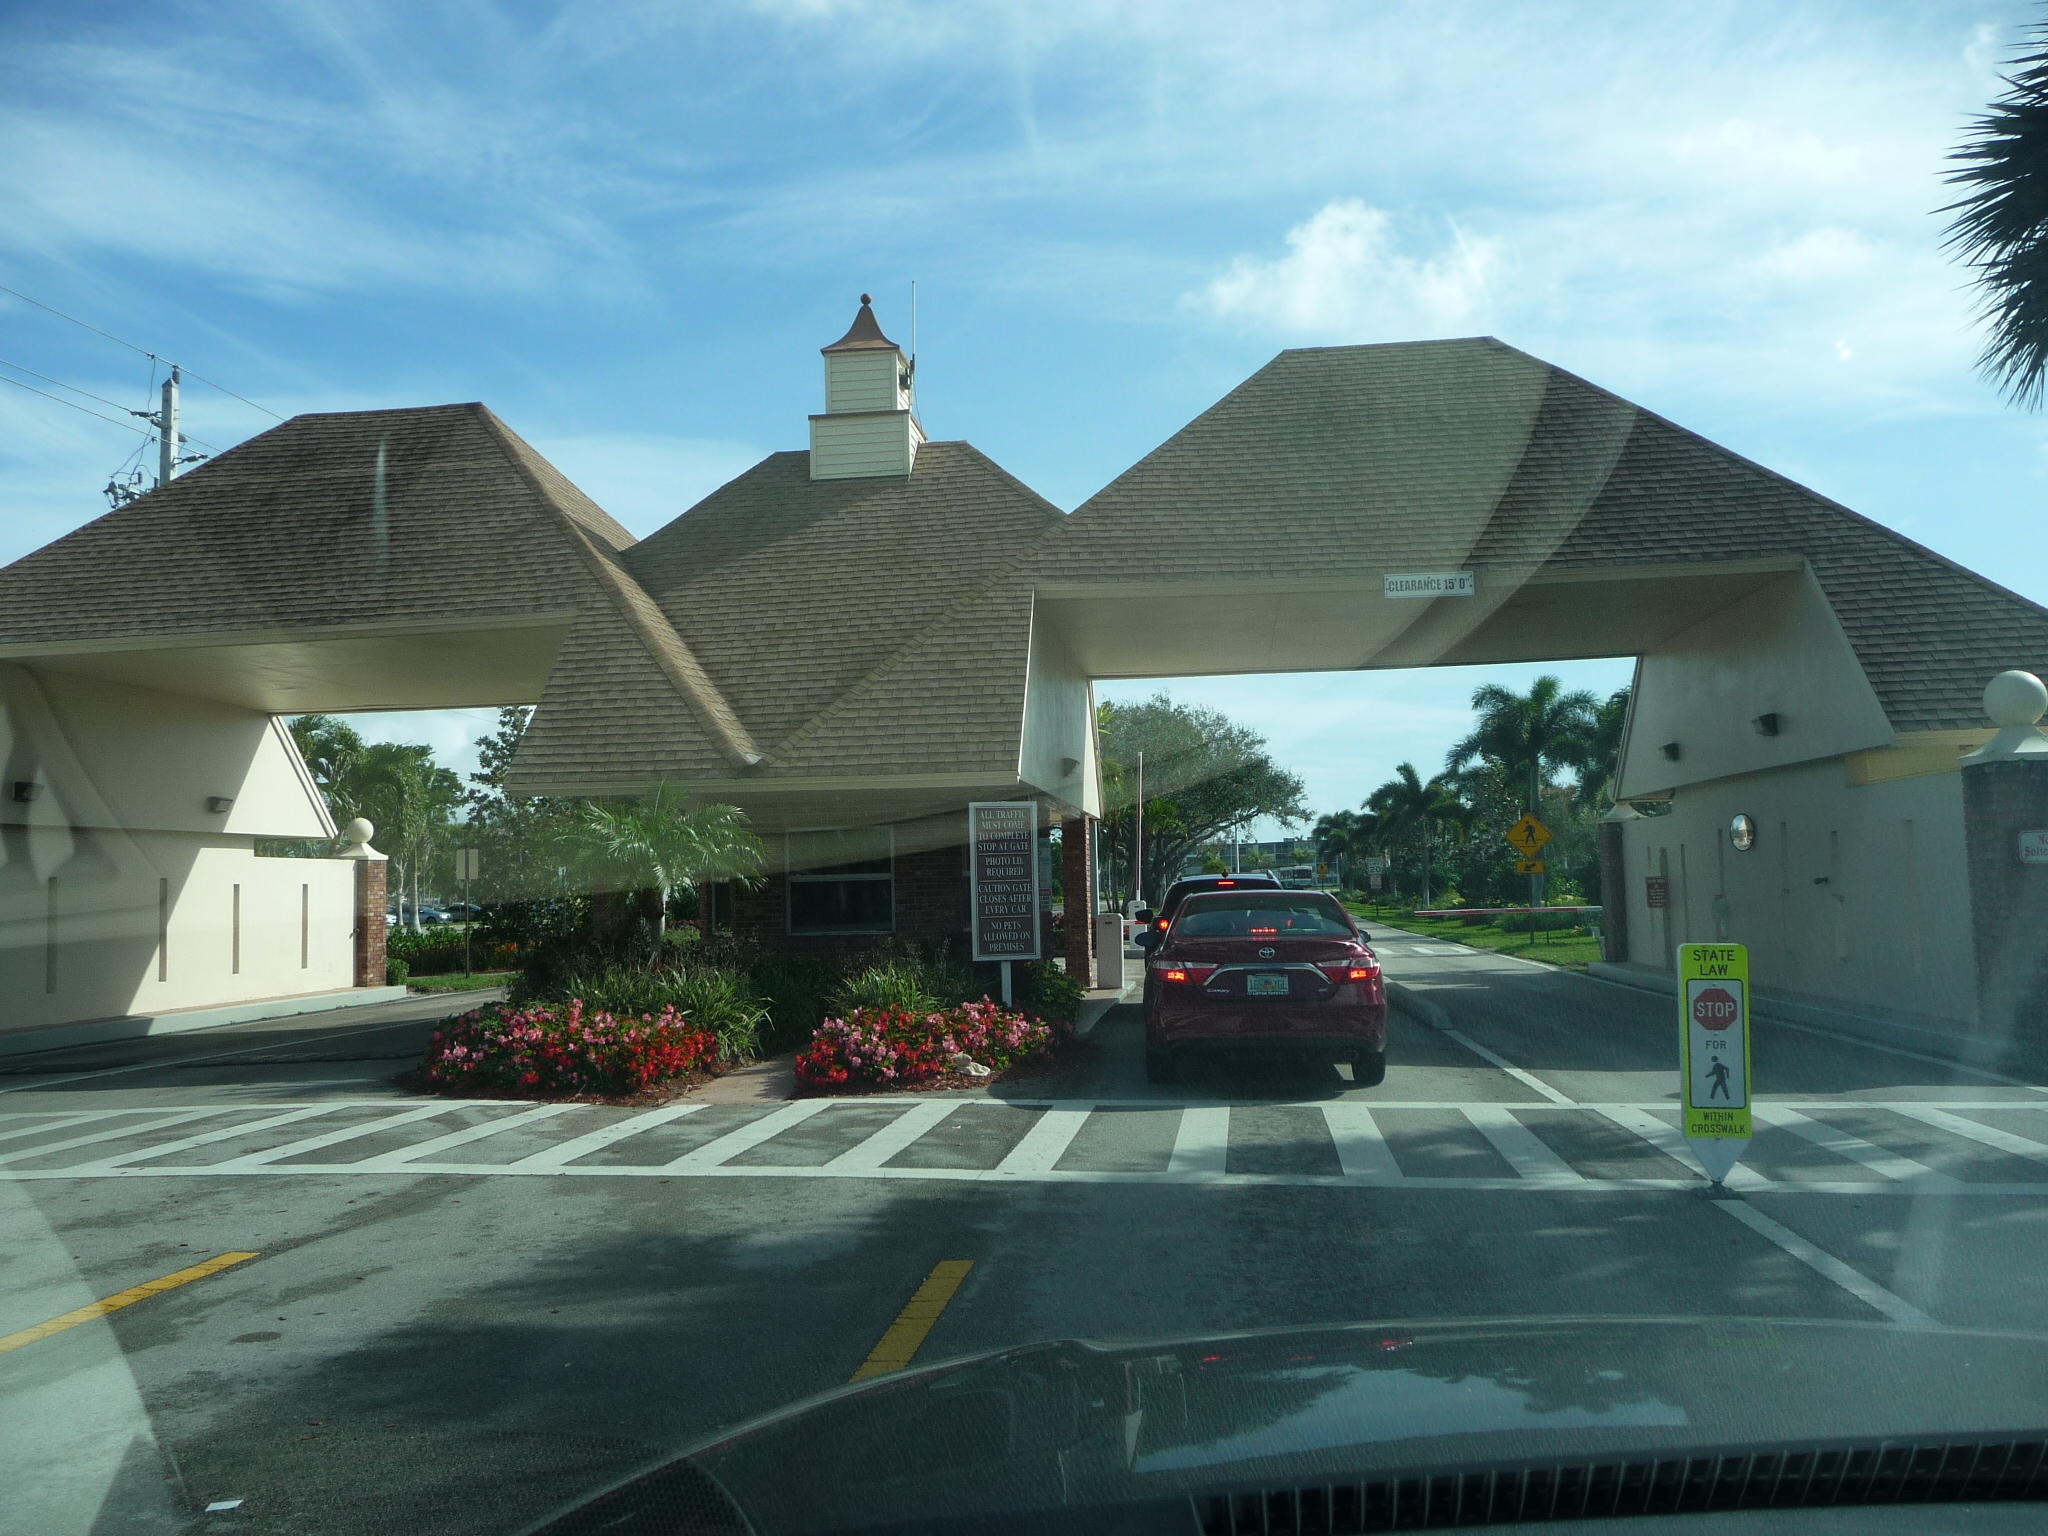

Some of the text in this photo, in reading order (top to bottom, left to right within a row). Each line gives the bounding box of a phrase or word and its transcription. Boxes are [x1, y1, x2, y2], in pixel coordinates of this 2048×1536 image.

[1388, 578, 1442, 592] CLEARANCE
[980, 810, 1025, 819] ALL TRAFFIC
[981, 820, 1025, 830] MUST COME
[979, 831, 1029, 840] TO COMPLETE
[978, 841, 1029, 851] STOP AT GATE
[985, 856, 1011, 866] PHOTO
[986, 867, 1024, 878] REQUIRED
[979, 883, 1033, 893] CAUTION GATE
[979, 894, 1007, 904] CLOSES
[1009, 894, 1032, 903] AFTER
[985, 904, 1027, 914] EVERY CAR
[991, 920, 1022, 930] NO PETS
[983, 930, 1031, 942] ALLOWED ON
[989, 942, 1025, 952] PREMISES
[1692, 949, 1736, 962] STATE
[1699, 964, 1729, 976] LAW
[1696, 1002, 1735, 1017] STOP
[1705, 1040, 1727, 1050] FOR
[1702, 1111, 1735, 1121] WITHIN
[1691, 1122, 1746, 1134] CROSSWALK
